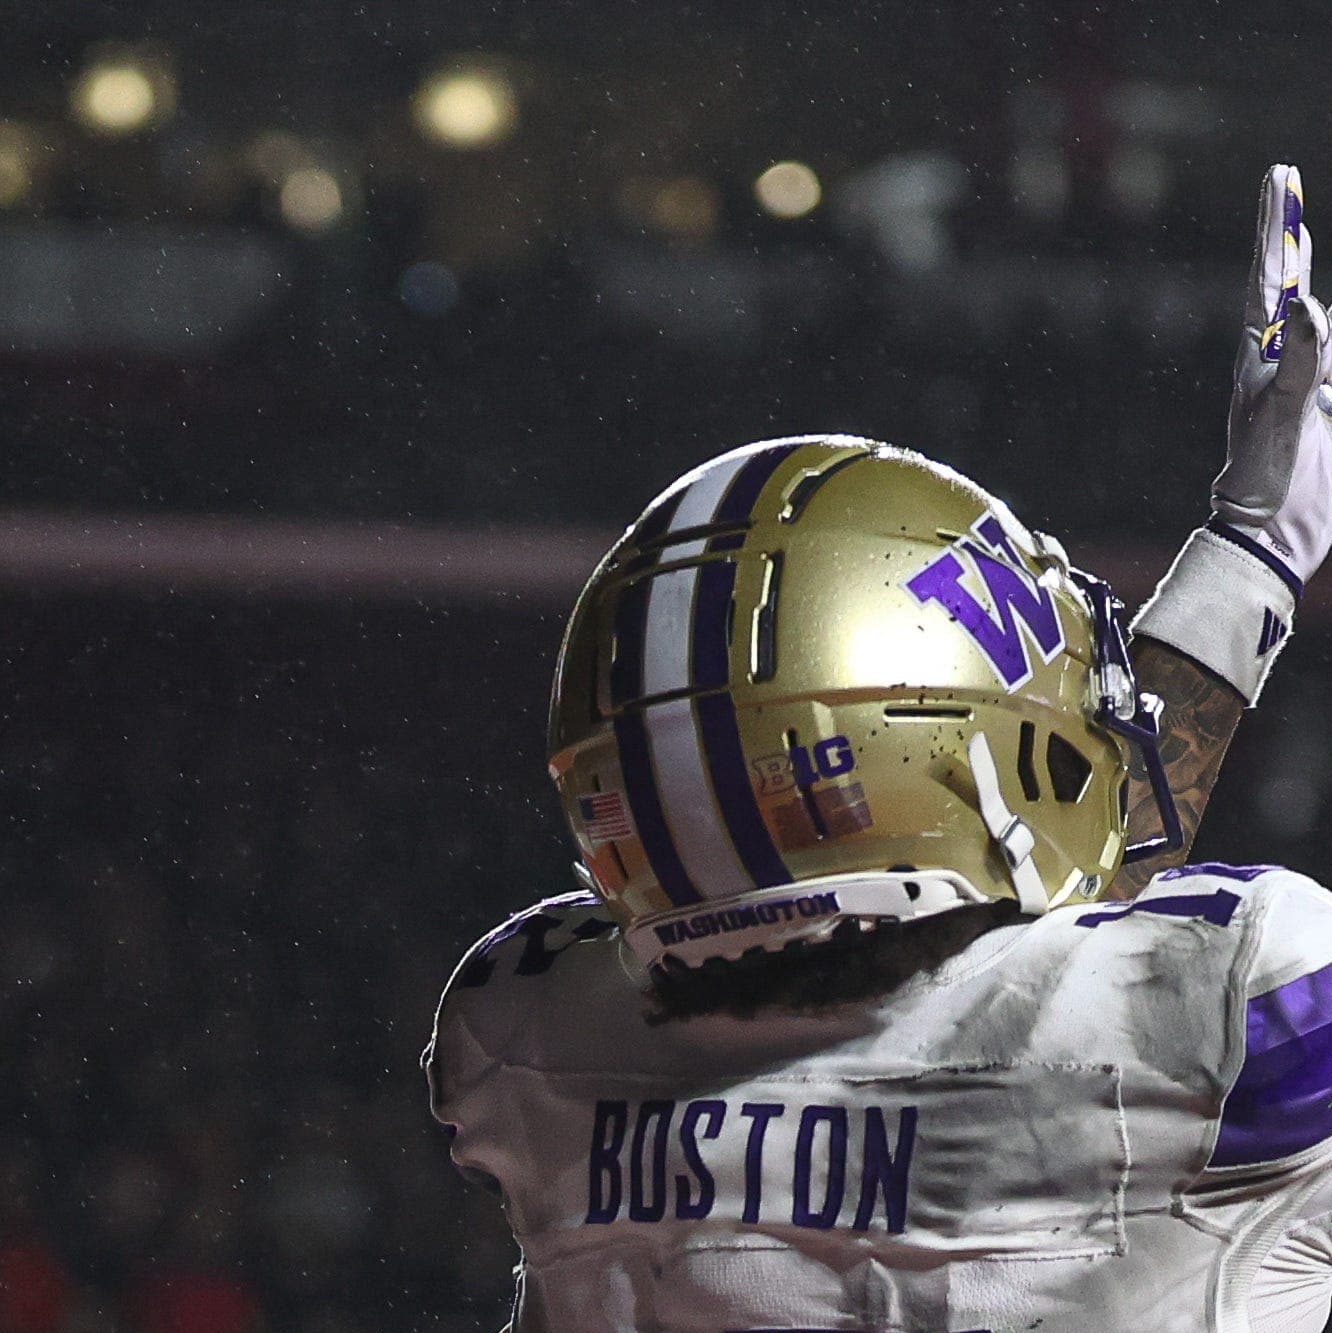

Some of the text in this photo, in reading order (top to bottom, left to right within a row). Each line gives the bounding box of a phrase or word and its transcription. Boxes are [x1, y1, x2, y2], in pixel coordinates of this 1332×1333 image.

[904, 510, 1066, 694] W
[653, 891, 841, 946] WASHINGTON
[585, 1099, 918, 1234] BOSTON
